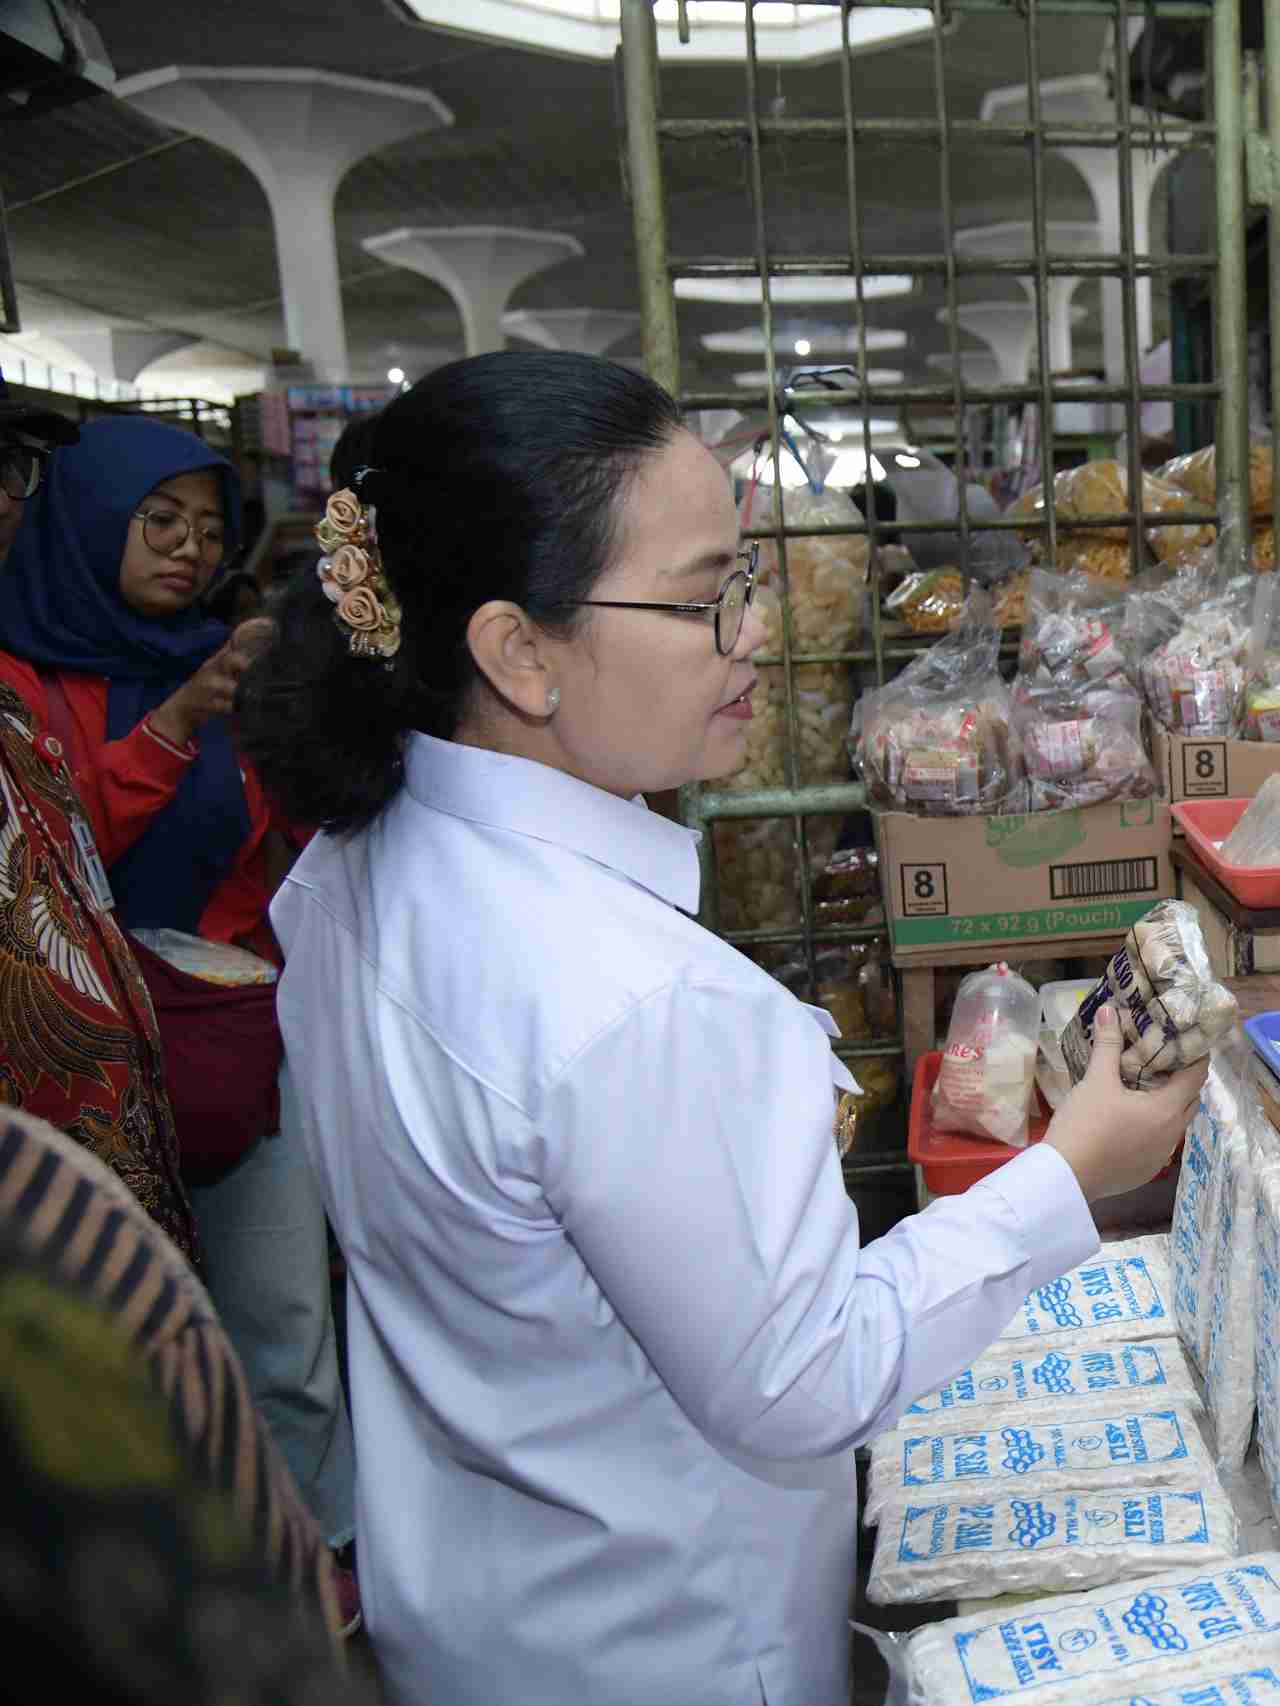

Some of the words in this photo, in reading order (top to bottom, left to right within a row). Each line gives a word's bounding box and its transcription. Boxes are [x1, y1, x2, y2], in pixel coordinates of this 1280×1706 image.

[1195, 749, 1215, 779] 8
[914, 869, 935, 899] 8
[952, 919, 973, 935] 72
[1046, 905, 1121, 930] (Pouch)
[1104, 1423, 1131, 1461] ASLI
[1121, 1499, 1146, 1538] ASLI
[1199, 1609, 1243, 1640] BP.
[1021, 1620, 1063, 1671] ASLI
